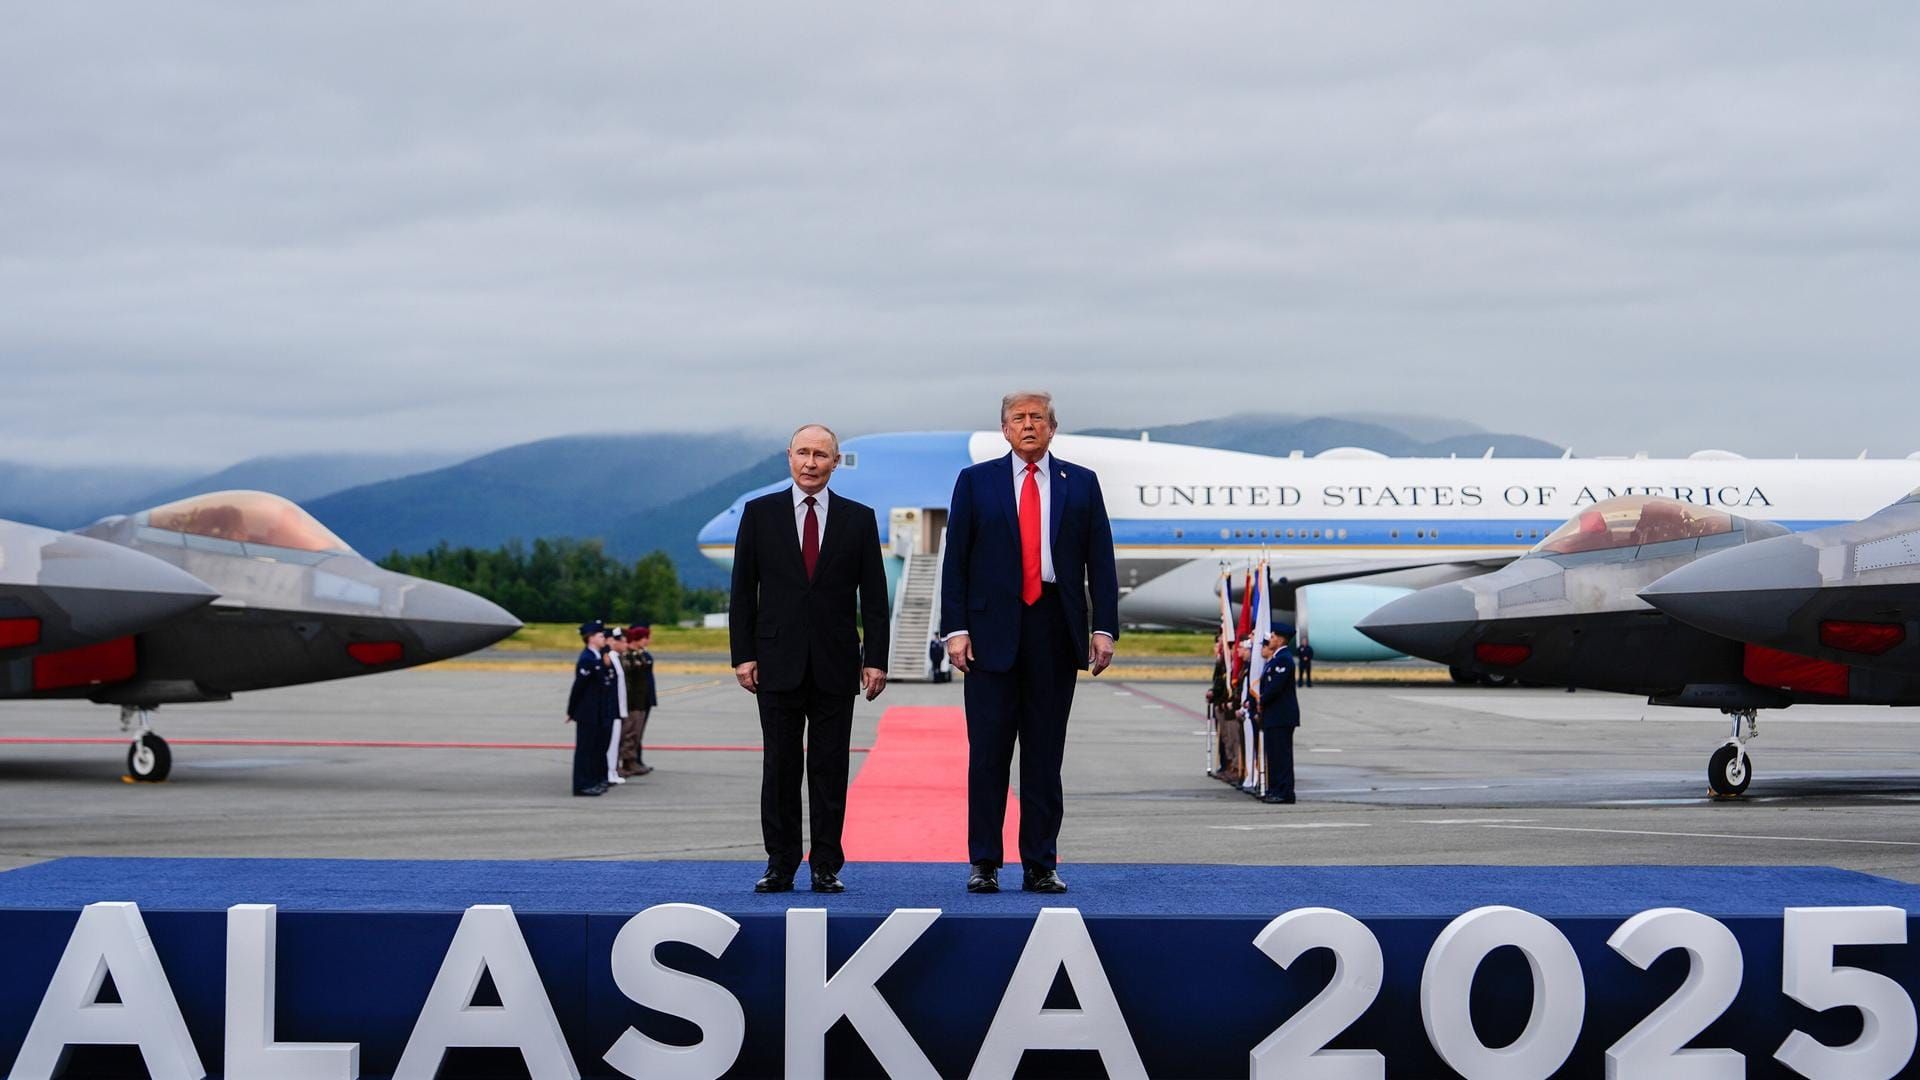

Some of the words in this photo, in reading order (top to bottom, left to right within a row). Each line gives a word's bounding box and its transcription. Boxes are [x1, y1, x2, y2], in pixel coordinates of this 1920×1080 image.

[1137, 485, 1302, 507] UNITED
[1322, 486, 1483, 507] STATES
[1503, 485, 1557, 507] OF
[8, 901, 1150, 1080] ALASKA
[1249, 905, 1918, 1080] 2025
